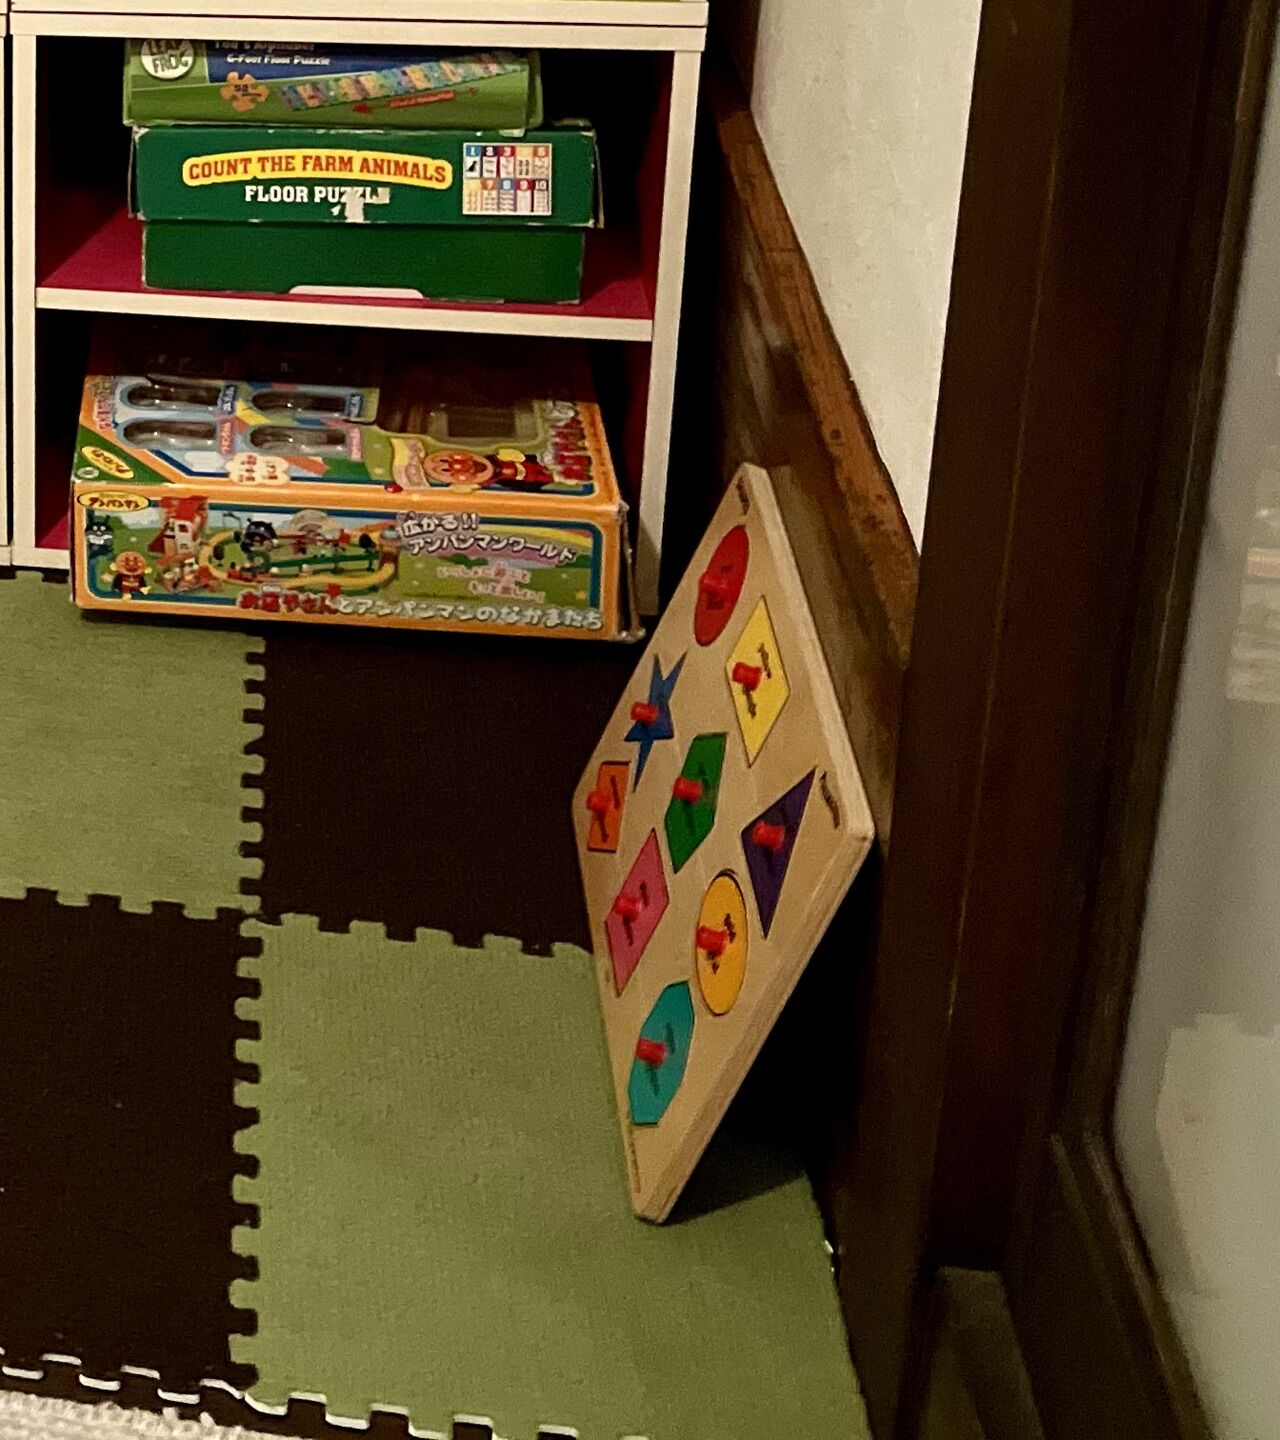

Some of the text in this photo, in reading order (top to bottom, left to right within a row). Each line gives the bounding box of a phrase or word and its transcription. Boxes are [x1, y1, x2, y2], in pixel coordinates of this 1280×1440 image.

[189, 155, 447, 184] COUNT THE FARM ANIMALS
[245, 185, 309, 203] FLOOR
[408, 534, 577, 562] アンパンマンワールド
